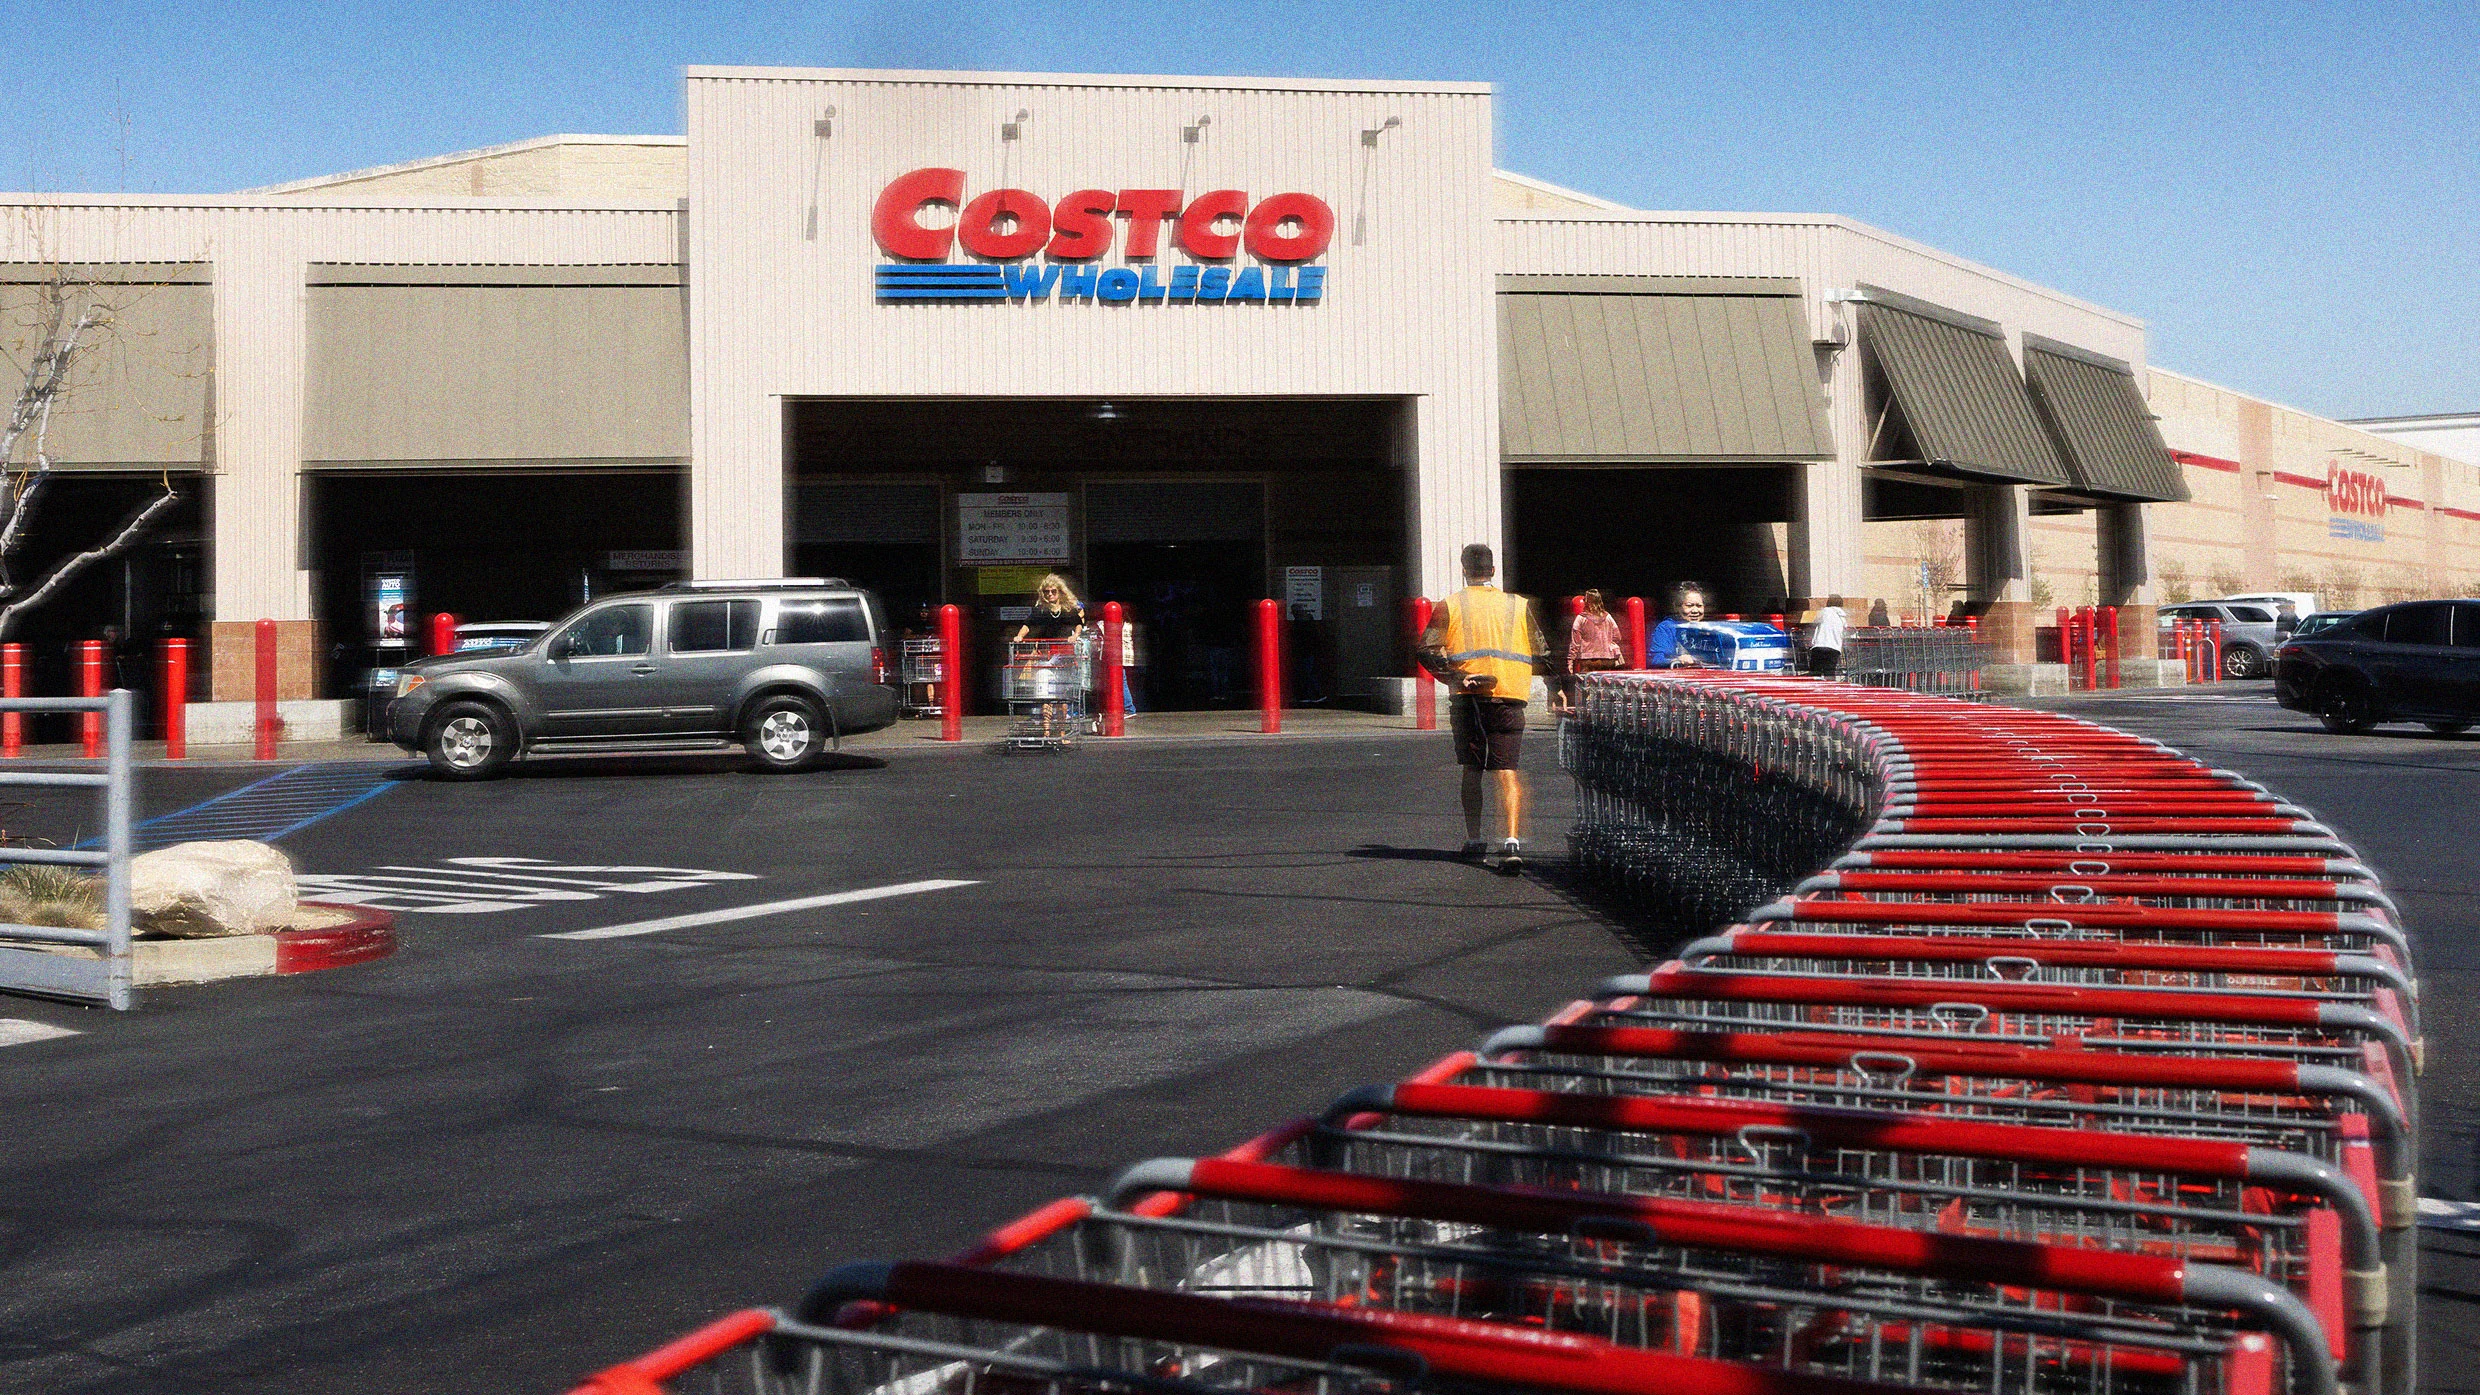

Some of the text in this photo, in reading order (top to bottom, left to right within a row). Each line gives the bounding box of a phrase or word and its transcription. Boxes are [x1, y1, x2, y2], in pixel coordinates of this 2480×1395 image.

[870, 167, 1335, 262] COSTCO
[1003, 265, 1329, 303] WHOLESALE
[2327, 458, 2386, 519] COSTCO
[983, 510, 1044, 518] MEMBERS ONLY
[968, 522, 986, 530] MON
[968, 536, 1008, 544] SATURDAY
[968, 548, 999, 556] SUNDAY
[626, 560, 670, 568] RETURNS
